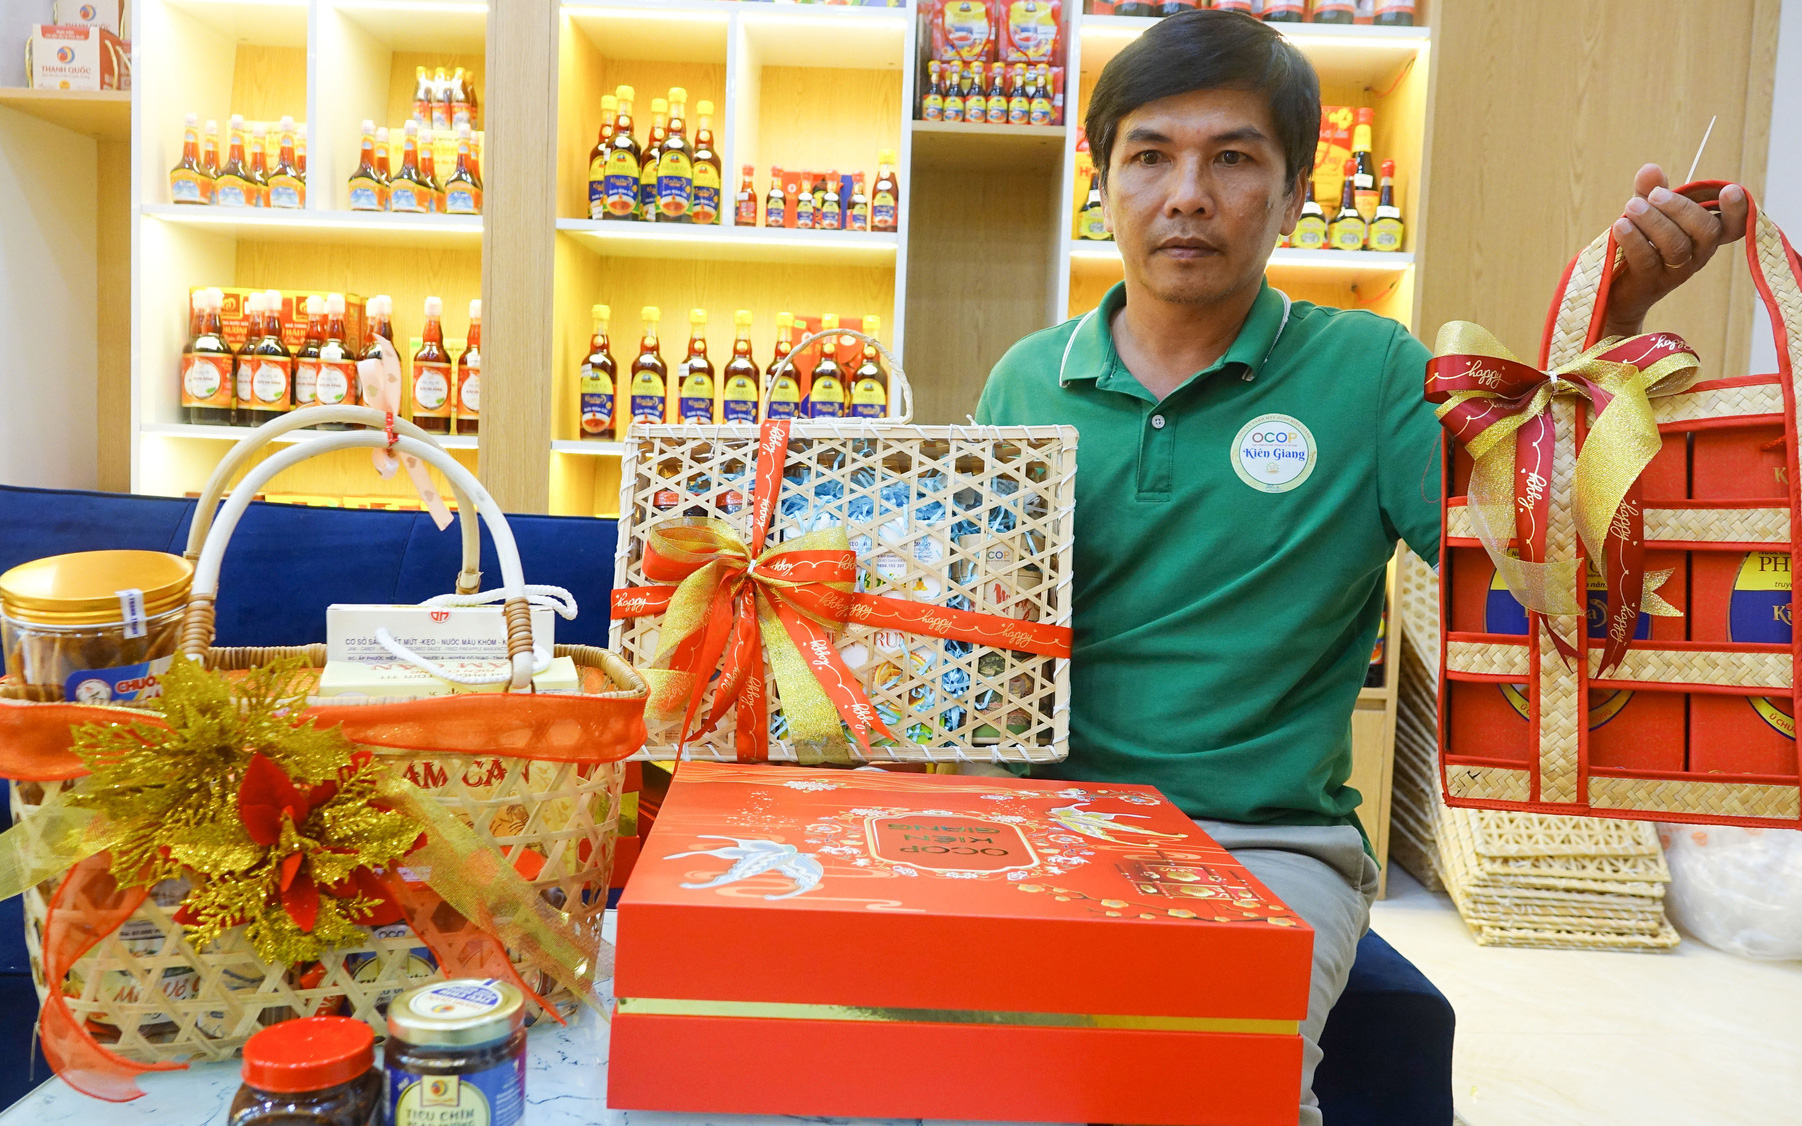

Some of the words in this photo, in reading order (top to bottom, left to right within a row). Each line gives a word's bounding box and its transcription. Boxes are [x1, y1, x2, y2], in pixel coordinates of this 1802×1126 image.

[1468, 359, 1503, 390] happy
[762, 424, 786, 454] happy
[1252, 432, 1298, 443] OCOP
[1243, 447, 1270, 459] Kiên
[1273, 447, 1306, 461] Giang
[1517, 472, 1547, 510] happy
[1609, 499, 1639, 541] happy
[986, 550, 1011, 560] COP
[1758, 556, 1790, 572] PH
[617, 592, 647, 613] happy
[921, 609, 954, 633] happy
[1610, 604, 1636, 643] happy
[1002, 622, 1036, 646] happy
[809, 639, 831, 666] happy
[887, 823, 1001, 834] GIANG
[899, 844, 1009, 857] OCOP
